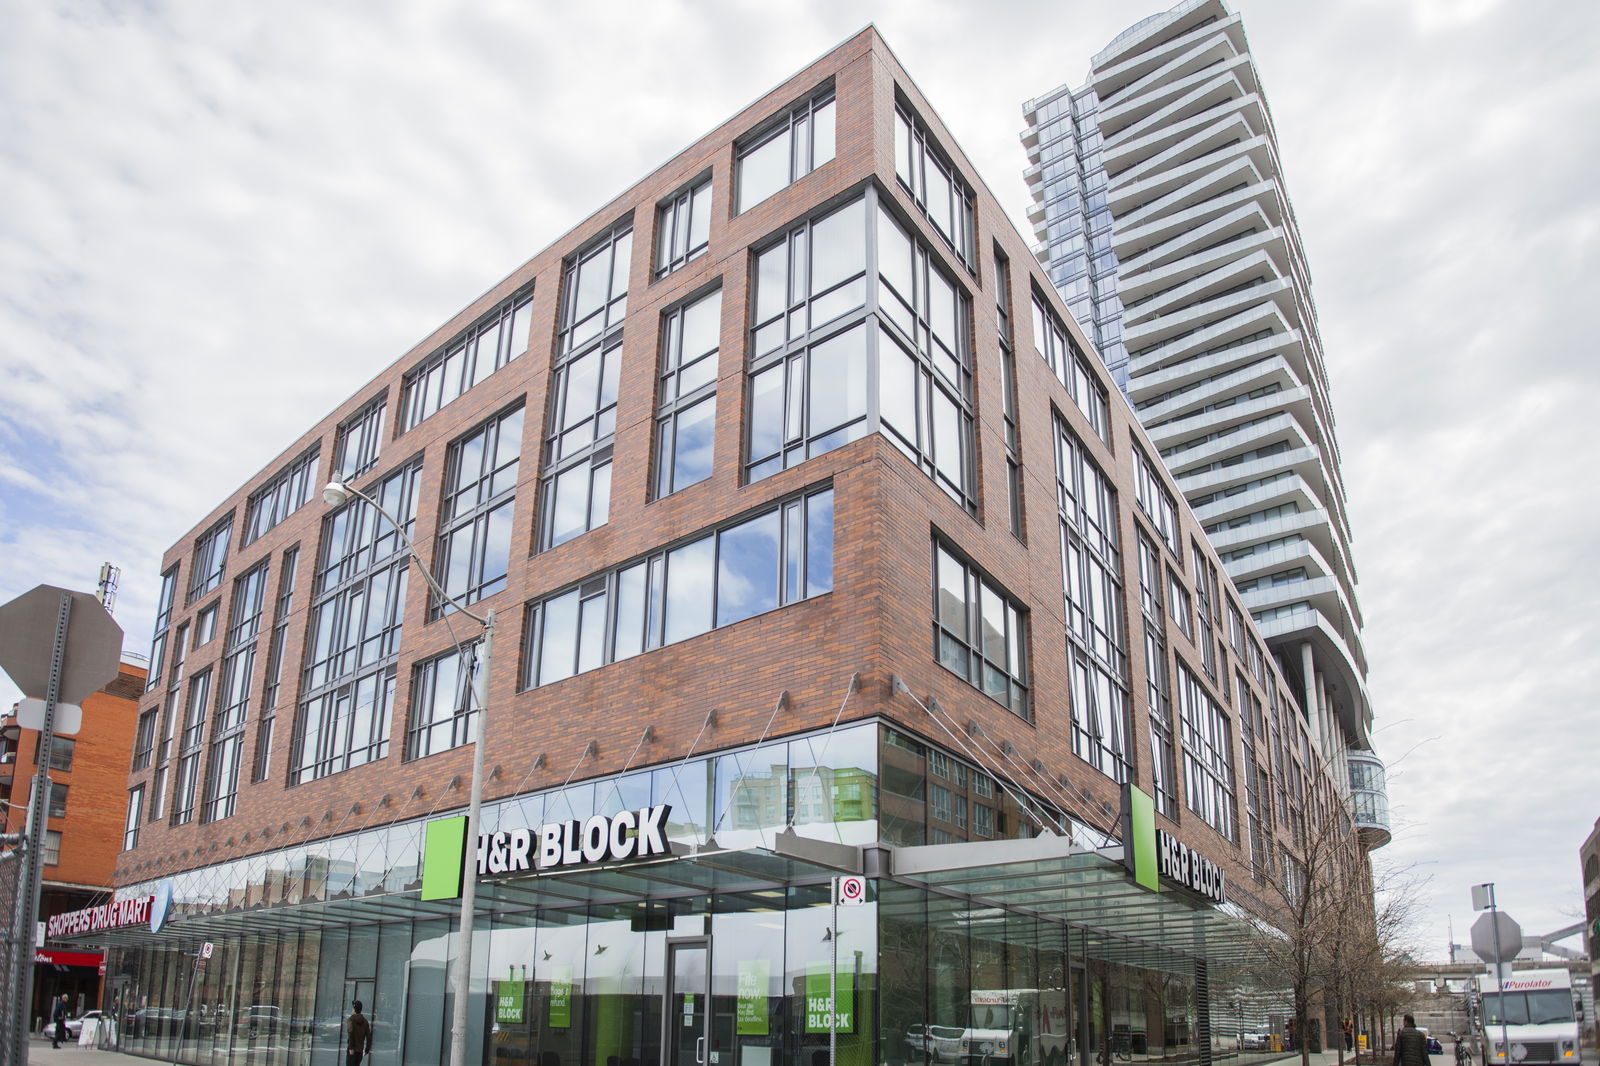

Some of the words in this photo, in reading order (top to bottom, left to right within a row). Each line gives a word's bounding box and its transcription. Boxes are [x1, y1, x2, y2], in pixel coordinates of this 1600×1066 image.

[477, 829, 531, 874] H&R
[541, 804, 668, 867] BLOCK
[1160, 830, 1190, 886] H&R
[1191, 849, 1226, 902] BLOCK
[48, 909, 91, 937] SHOPPERS
[91, 903, 118, 930] DRUG
[117, 897, 150, 926] MART
[1509, 980, 1552, 989] Purolator
[499, 996, 514, 1007] H&R
[498, 1008, 521, 1019] BLOCK
[808, 1013, 849, 1028] BLOCK
